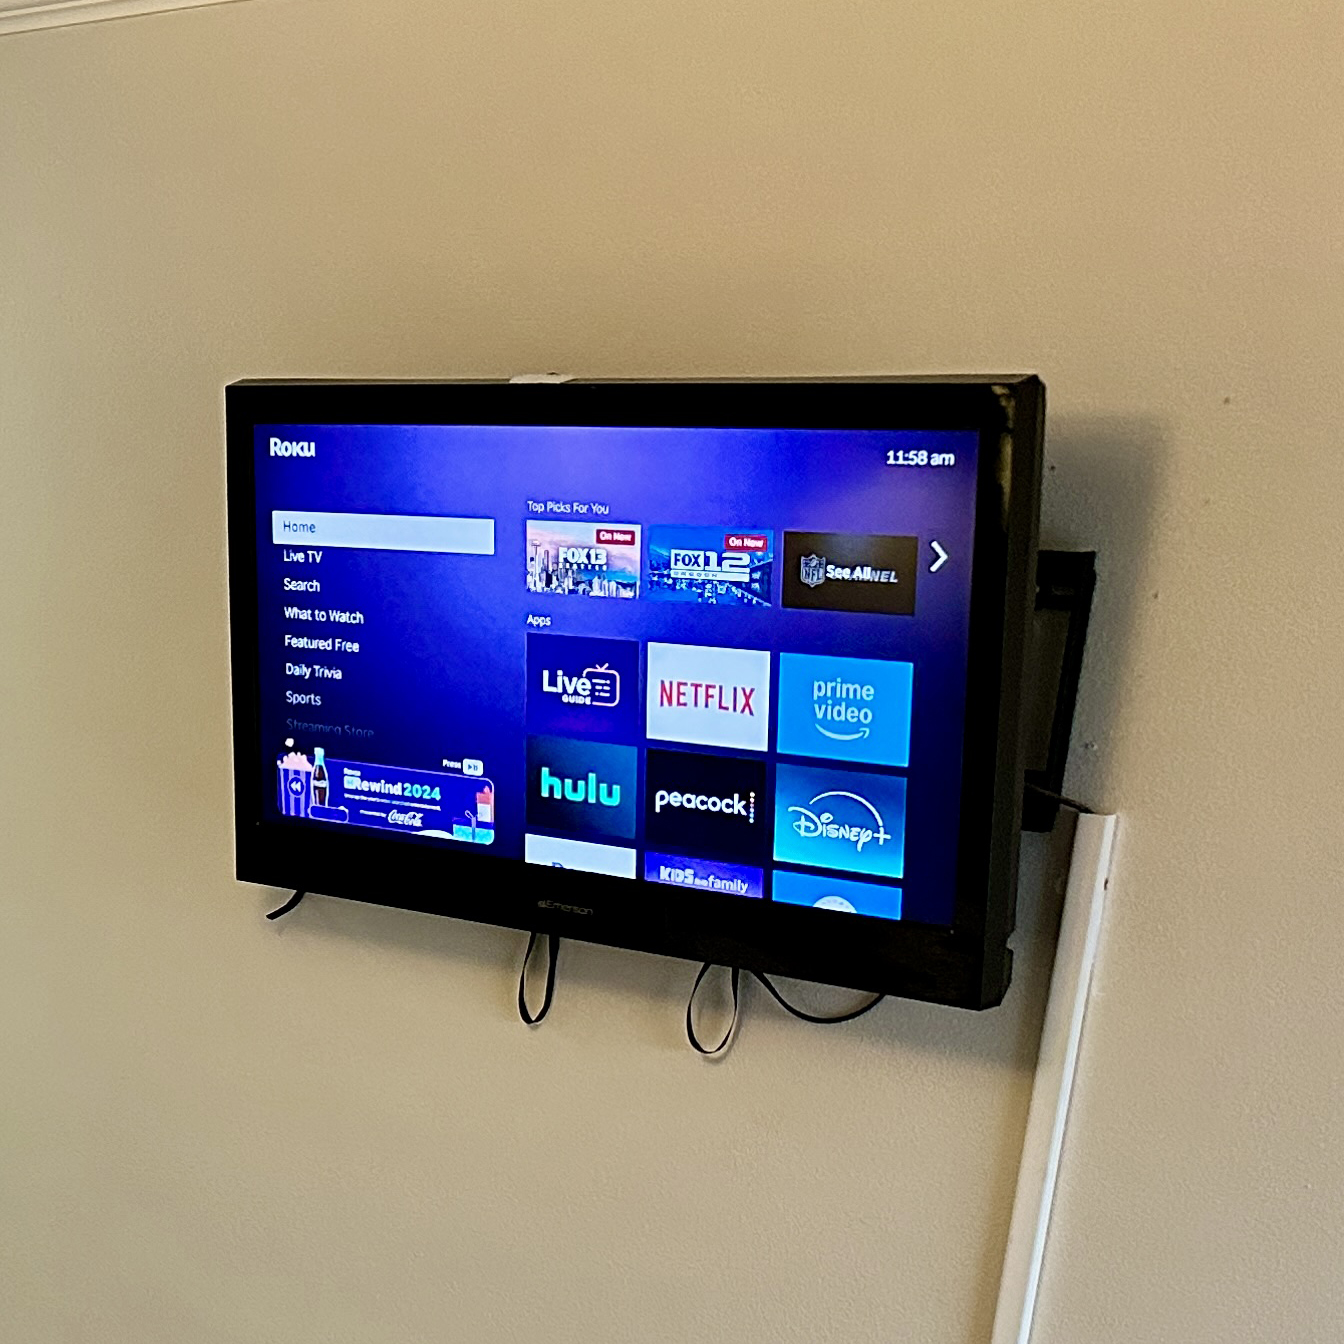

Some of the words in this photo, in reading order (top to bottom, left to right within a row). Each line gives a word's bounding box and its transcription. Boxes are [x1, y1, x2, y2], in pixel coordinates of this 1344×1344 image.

[269, 437, 316, 457] Roku
[886, 450, 928, 466] 11:58
[930, 452, 955, 466] am
[527, 501, 544, 513] Top
[547, 501, 571, 513] Picks
[573, 503, 589, 514] For
[590, 503, 609, 515] You
[282, 521, 316, 534] Home
[599, 531, 612, 541] On
[728, 537, 742, 547] On
[283, 549, 305, 563] Live
[307, 550, 323, 563] TV
[673, 553, 701, 567] FOX
[705, 551, 750, 574] 12
[825, 564, 851, 579] See
[283, 578, 321, 592] Search
[284, 606, 312, 620] What
[314, 610, 327, 621] to
[328, 610, 365, 624] Watch
[526, 614, 551, 627] Apps
[284, 634, 333, 651] Featured
[335, 639, 360, 653] Free
[285, 663, 311, 679] Daily
[313, 665, 343, 679] Trivia
[542, 669, 592, 696] Live
[813, 677, 875, 702] prime
[285, 690, 322, 706] Sports
[659, 679, 756, 717] NETFLIX
[813, 700, 873, 724] video
[344, 725, 375, 738] Store
[403, 782, 441, 801] 2024
[540, 766, 621, 807] hulu
[655, 790, 748, 816] peacock
[659, 865, 695, 885] KIDS
[708, 874, 749, 894] family
